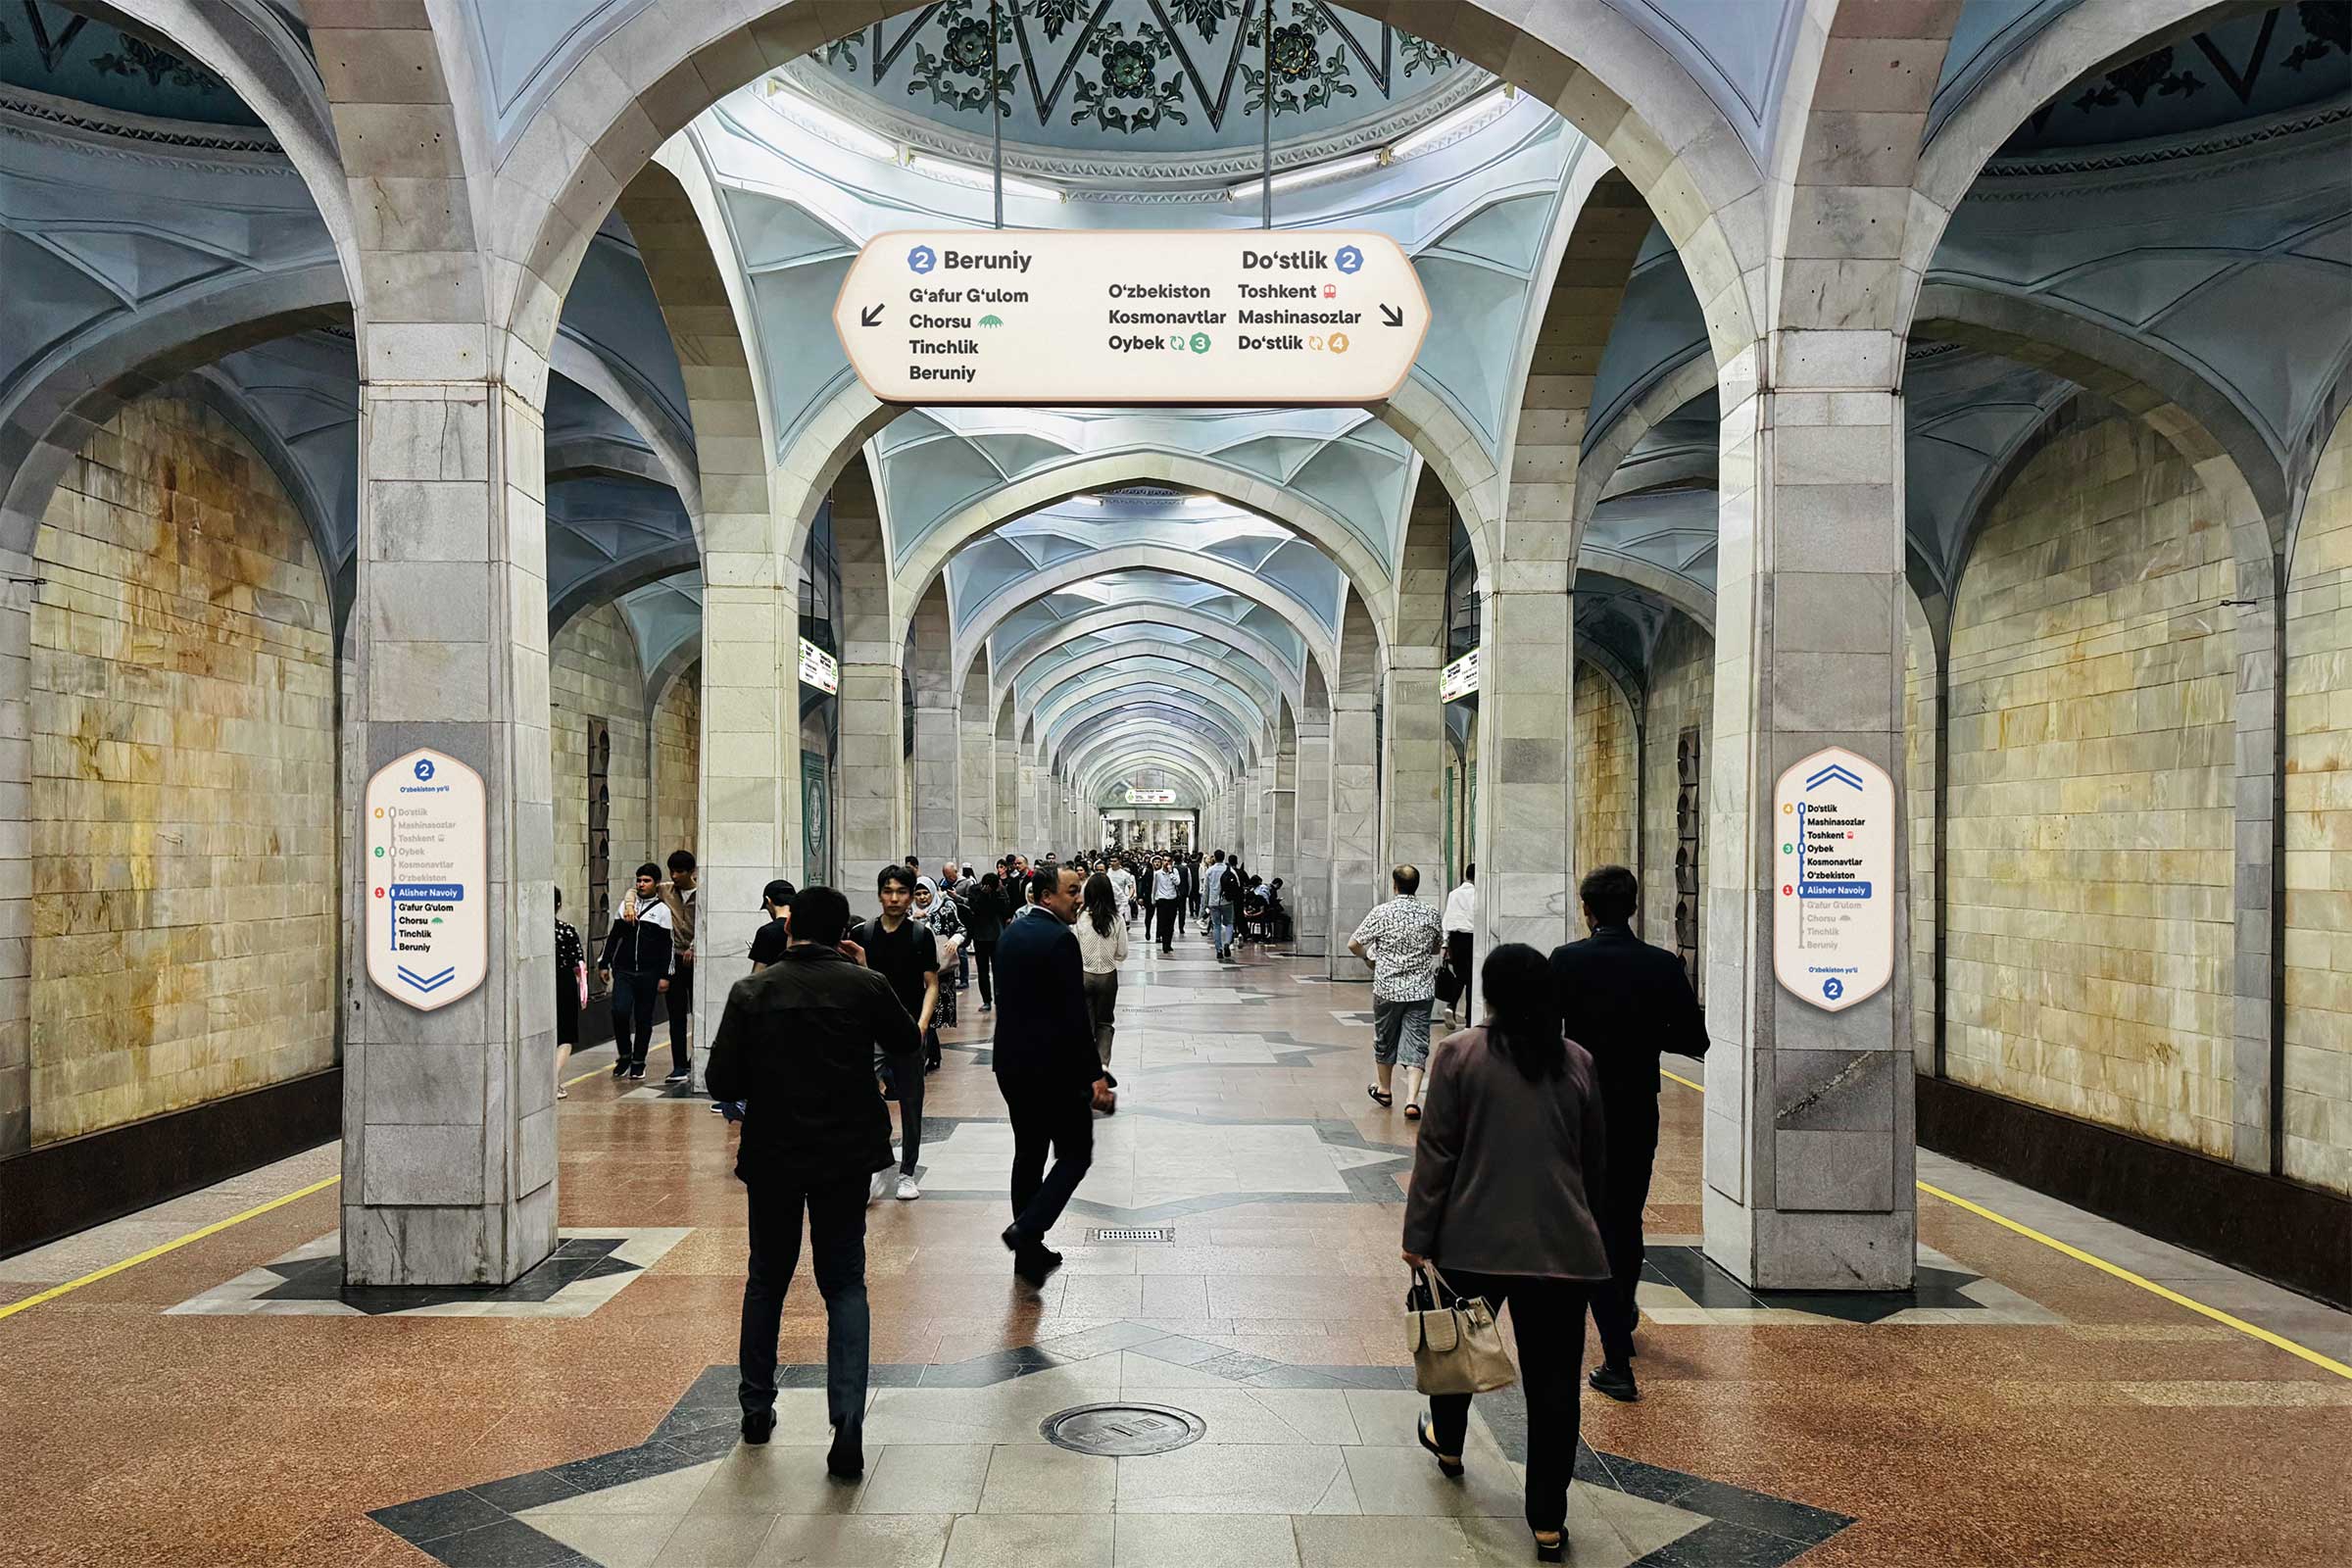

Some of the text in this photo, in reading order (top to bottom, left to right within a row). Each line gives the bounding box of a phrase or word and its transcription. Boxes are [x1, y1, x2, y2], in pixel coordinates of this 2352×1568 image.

[915, 250, 1032, 272] 2 Beruniy
[1243, 250, 1356, 270] Do‘stlik 2
[909, 288, 1028, 303] G‘afur G‘ulom
[1108, 283, 1210, 299] O‘zbekiston
[1239, 283, 1316, 299] Toshkent
[909, 314, 971, 328] Chorsu
[1108, 309, 1226, 324] Kosmonavtlar
[1239, 309, 1361, 324] Mashinasozlar
[909, 340, 979, 354] Tinchlik
[1108, 335, 1205, 353] Oybek 3
[1239, 335, 1344, 350] Do‘stlik 4
[909, 366, 976, 382] Beruniy
[419, 764, 429, 776] 2
[1807, 831, 1844, 840] Toshkent
[399, 848, 424, 857] Oybek
[1807, 845, 1834, 855] Oybek
[399, 860, 454, 869] Kosmonavtlar
[1807, 871, 1855, 880] O‘zbekiston
[399, 888, 427, 897] Alisher
[430, 888, 458, 899] Navoiy
[1807, 886, 1837, 895] Alisher
[1838, 886, 1866, 897] Navoiy
[399, 916, 428, 925] Chorsu
[1807, 927, 1839, 936] Tinchlik
[399, 943, 430, 953] Beruniy
[1807, 941, 1838, 951] Beruniy
[1828, 983, 1838, 995] 2
